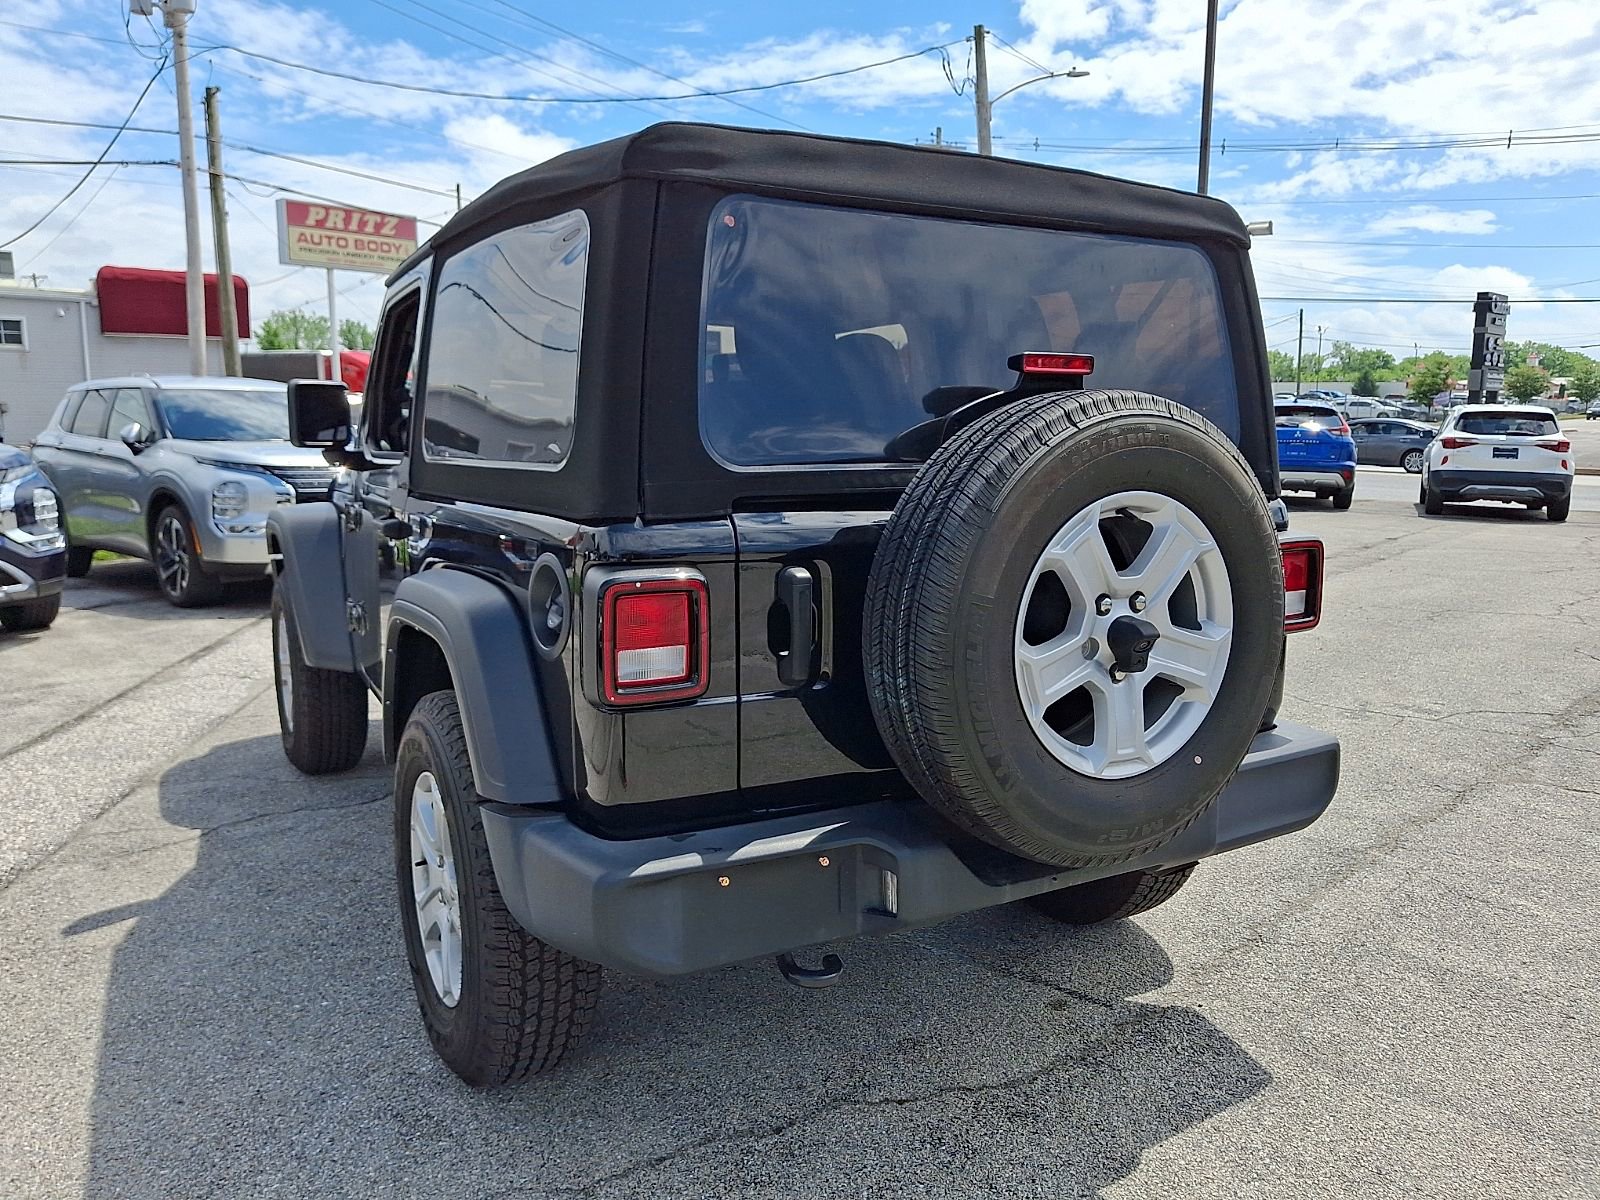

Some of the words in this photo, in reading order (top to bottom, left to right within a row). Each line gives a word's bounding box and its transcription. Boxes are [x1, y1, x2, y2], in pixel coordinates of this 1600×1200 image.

[305, 206, 402, 235] PRITZ
[297, 232, 348, 249] AUTO
[354, 239, 403, 255] BODY
